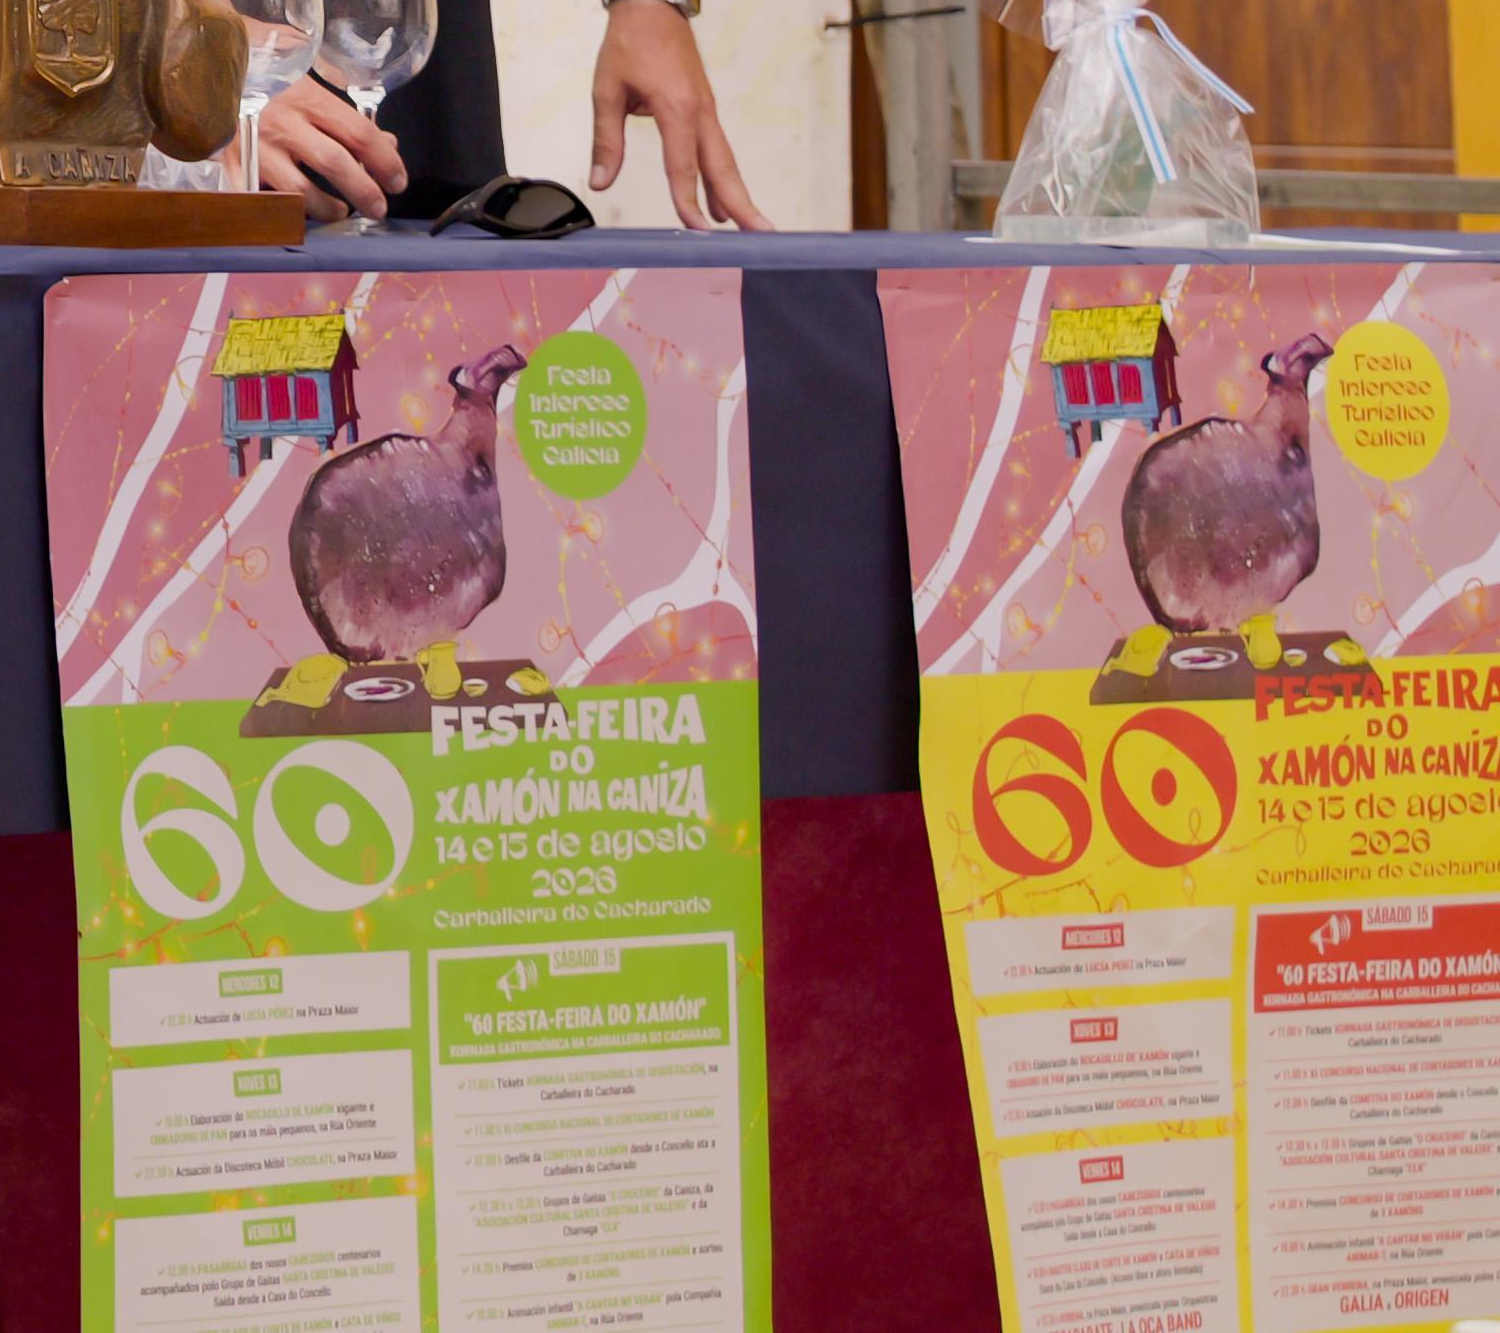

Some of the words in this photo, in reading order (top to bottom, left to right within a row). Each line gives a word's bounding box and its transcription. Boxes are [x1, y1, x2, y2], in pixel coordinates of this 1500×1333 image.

[431, 693, 706, 757] FESTA-FEIRA
[1367, 714, 1408, 740] DO
[550, 745, 595, 775] DO
[1258, 734, 1375, 788] XAMÓN
[1385, 747, 1416, 776] NA
[435, 767, 560, 825] XAMÓN
[568, 780, 602, 812] NA
[971, 706, 1238, 876] 60
[1259, 798, 1285, 824] 14
[1293, 800, 1312, 822] e
[1319, 796, 1345, 821] 15
[1355, 793, 1397, 820] de
[120, 739, 416, 920] 60
[434, 835, 468, 863] 14
[472, 836, 494, 862] e
[498, 832, 528, 860] 15
[536, 829, 581, 859] de
[590, 823, 707, 861] agosto
[1350, 829, 1431, 856] 2026
[532, 865, 618, 898] 2026
[563, 903, 589, 921] do
[1367, 906, 1411, 925] SÁBADO
[1418, 906, 1428, 922] 15
[1308, 959, 1414, 985] FESTA-FEIRA
[1419, 957, 1441, 978] DO
[497, 1007, 600, 1033] FESTA-FEIRA
[608, 1004, 630, 1025] DO
